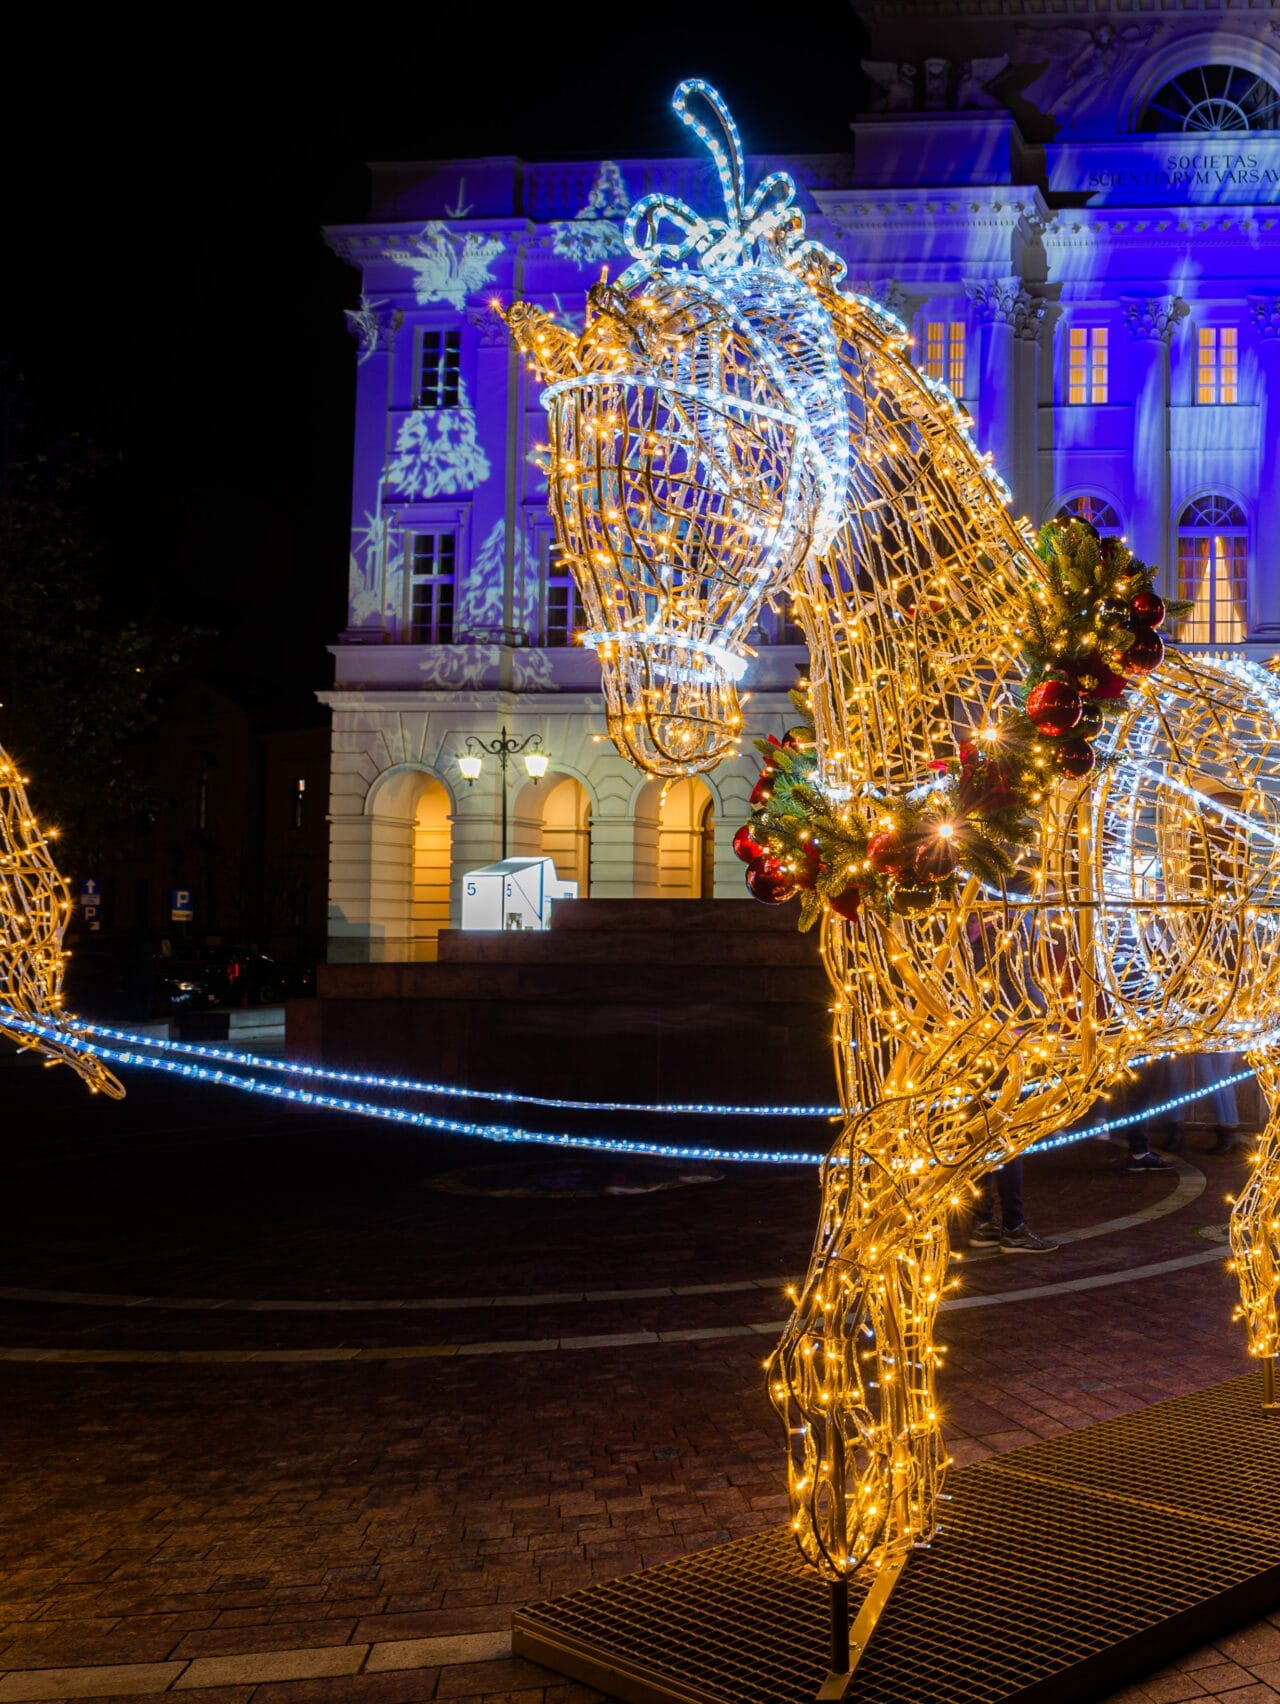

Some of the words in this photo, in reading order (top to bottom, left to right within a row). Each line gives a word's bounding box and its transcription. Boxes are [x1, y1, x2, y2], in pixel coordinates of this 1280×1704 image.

[1167, 154, 1257, 170] SOCIETAS
[467, 882, 477, 896] 5
[506, 883, 512, 897] 5
[176, 890, 190, 908] P
[84, 906, 96, 920] P
